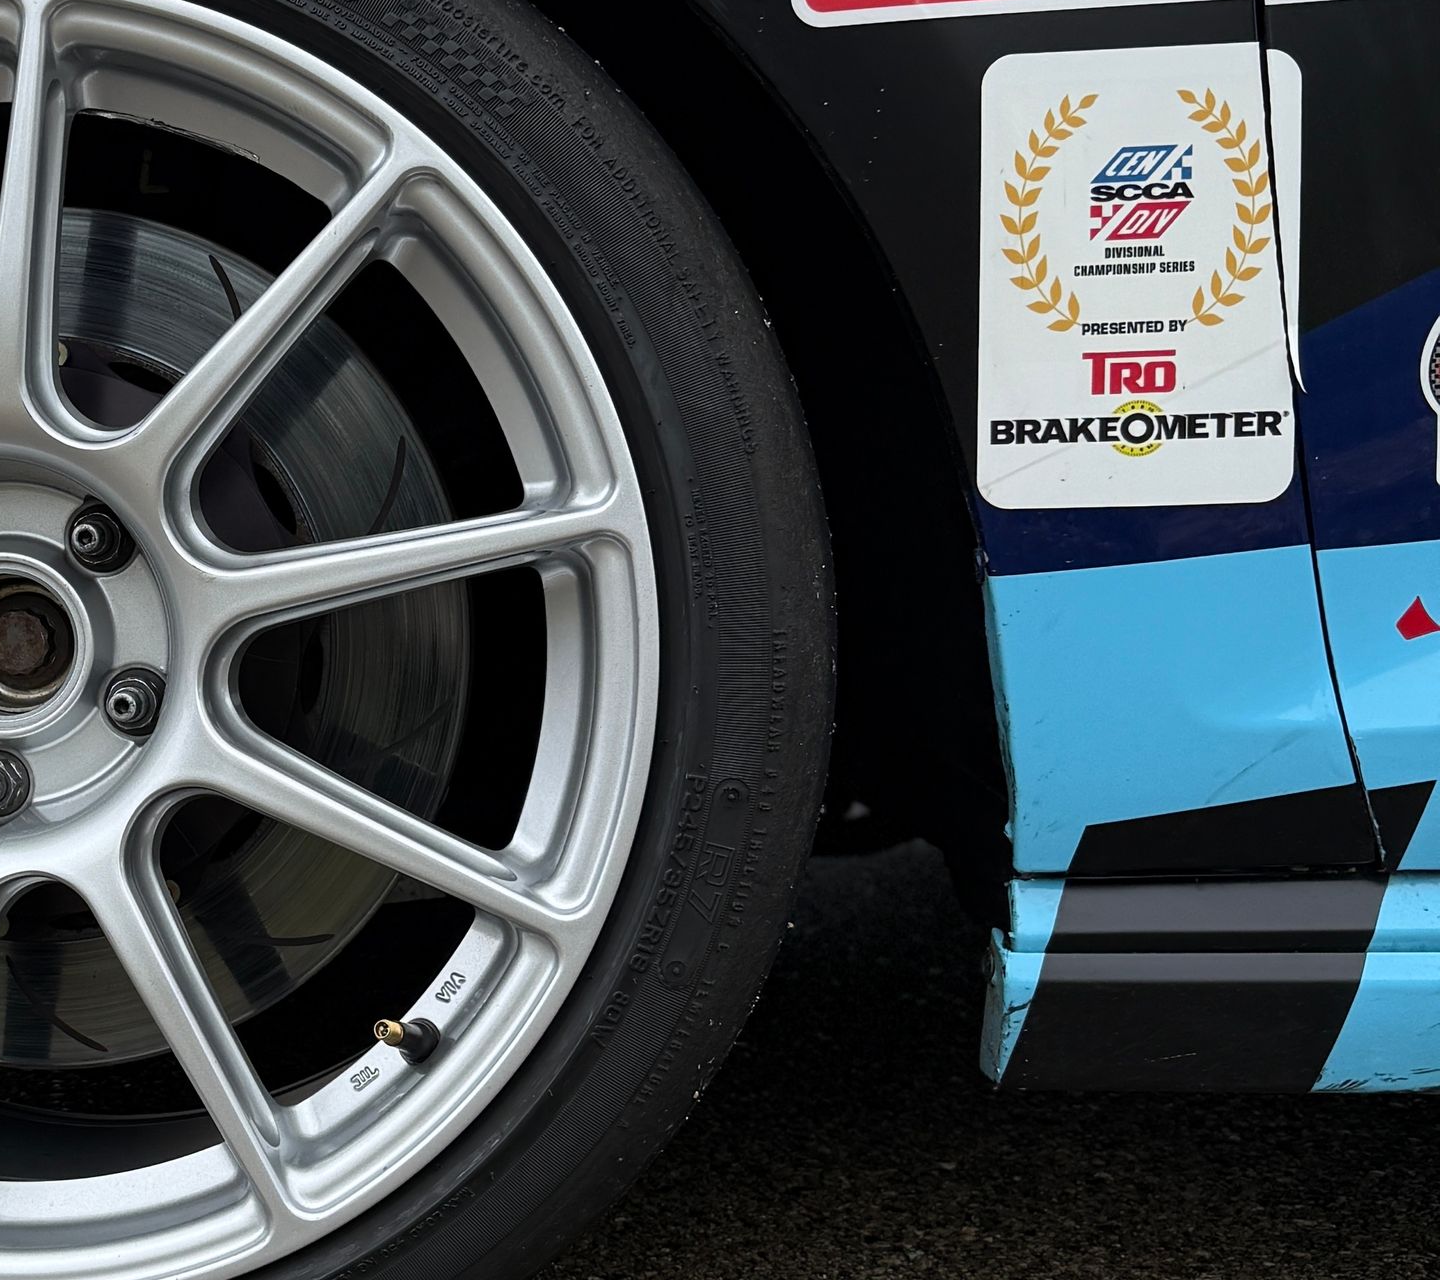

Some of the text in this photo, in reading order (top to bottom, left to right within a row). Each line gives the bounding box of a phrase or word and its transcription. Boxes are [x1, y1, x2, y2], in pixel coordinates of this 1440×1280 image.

[1104, 151, 1167, 177] CEN
[1090, 182, 1194, 202] SCCA
[1117, 208, 1179, 235] DIV
[1105, 245, 1165, 259] DIVISIONAL
[1074, 260, 1195, 277] CHAMPIONSHIP SERIES
[1082, 319, 1188, 336] PRESENTED BY
[676, 841, 738, 924] R7
